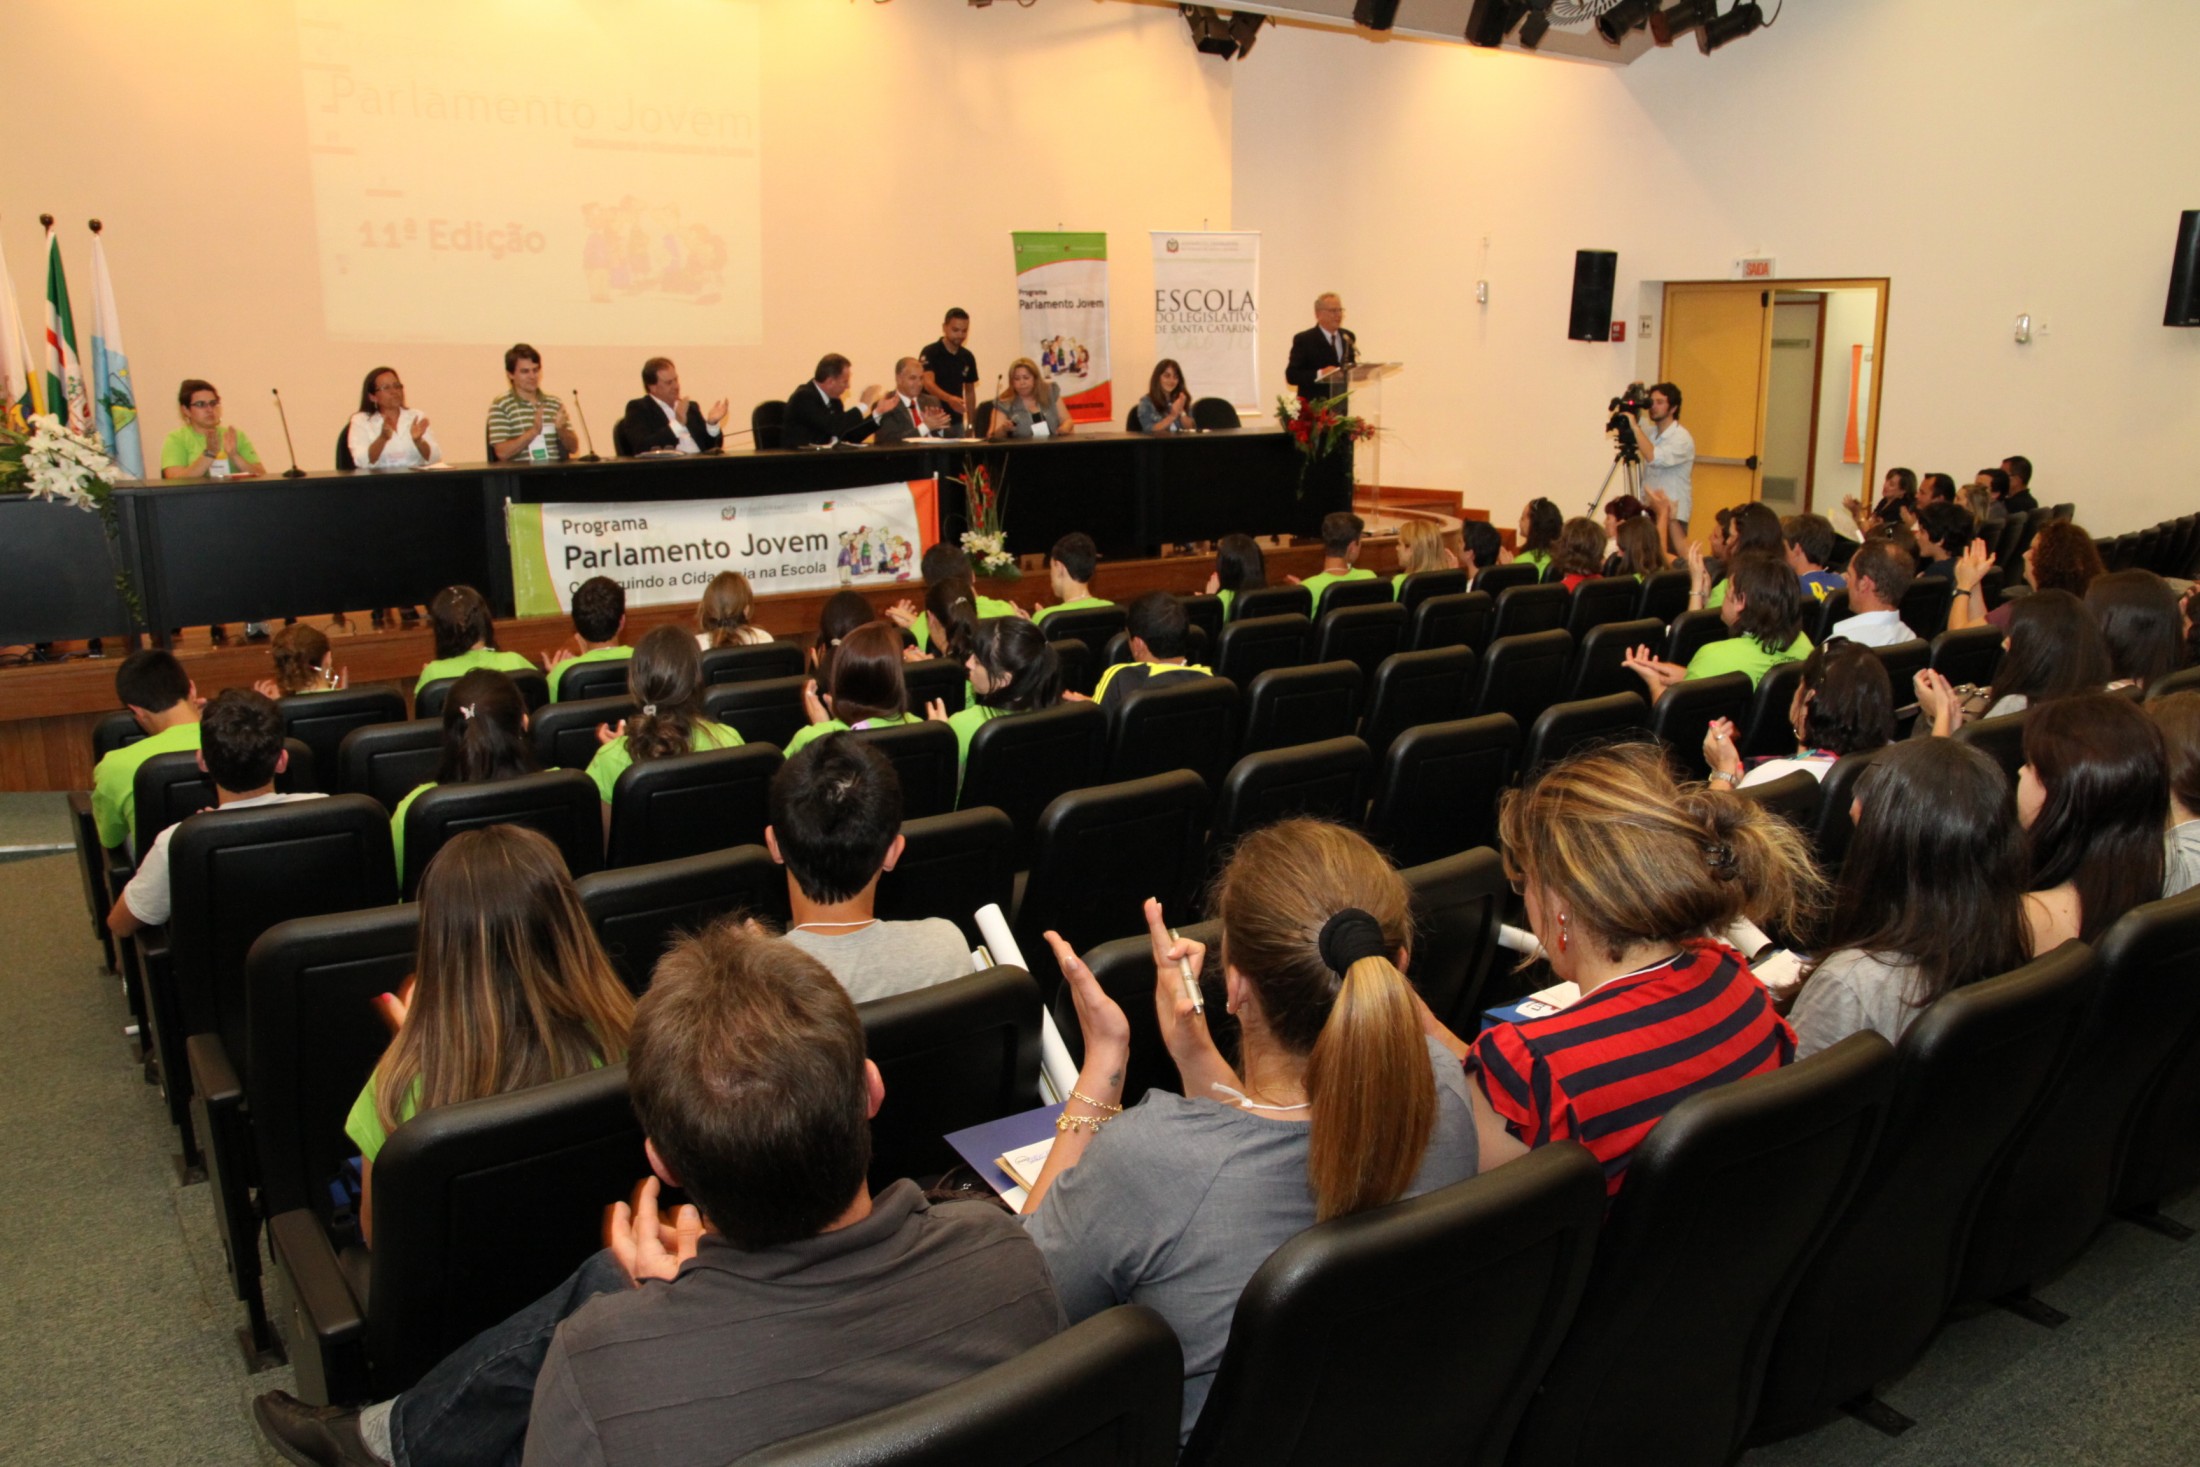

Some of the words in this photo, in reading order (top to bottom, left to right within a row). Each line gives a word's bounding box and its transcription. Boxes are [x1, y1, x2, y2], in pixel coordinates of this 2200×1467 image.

[332, 74, 597, 130] Parlamento
[614, 93, 753, 138] Jovem
[428, 218, 547, 260] Edição
[1020, 299, 1074, 310] Parlamento
[1076, 298, 1104, 309] Jovem
[1155, 288, 1255, 313] ESCOLA
[1155, 312, 1175, 323] DO
[1179, 312, 1259, 323] LEGISLATIVO
[1155, 324, 1167, 334] DE
[1171, 324, 1204, 334] SANTA
[1206, 324, 1258, 334] CATARINA
[562, 518, 648, 536] Programa
[564, 538, 731, 570] Parlamento
[740, 533, 829, 557] Jovem
[669, 577, 677, 586] a
[682, 567, 756, 585] Cidaia
[760, 568, 777, 578] na
[781, 562, 827, 577] Escola
